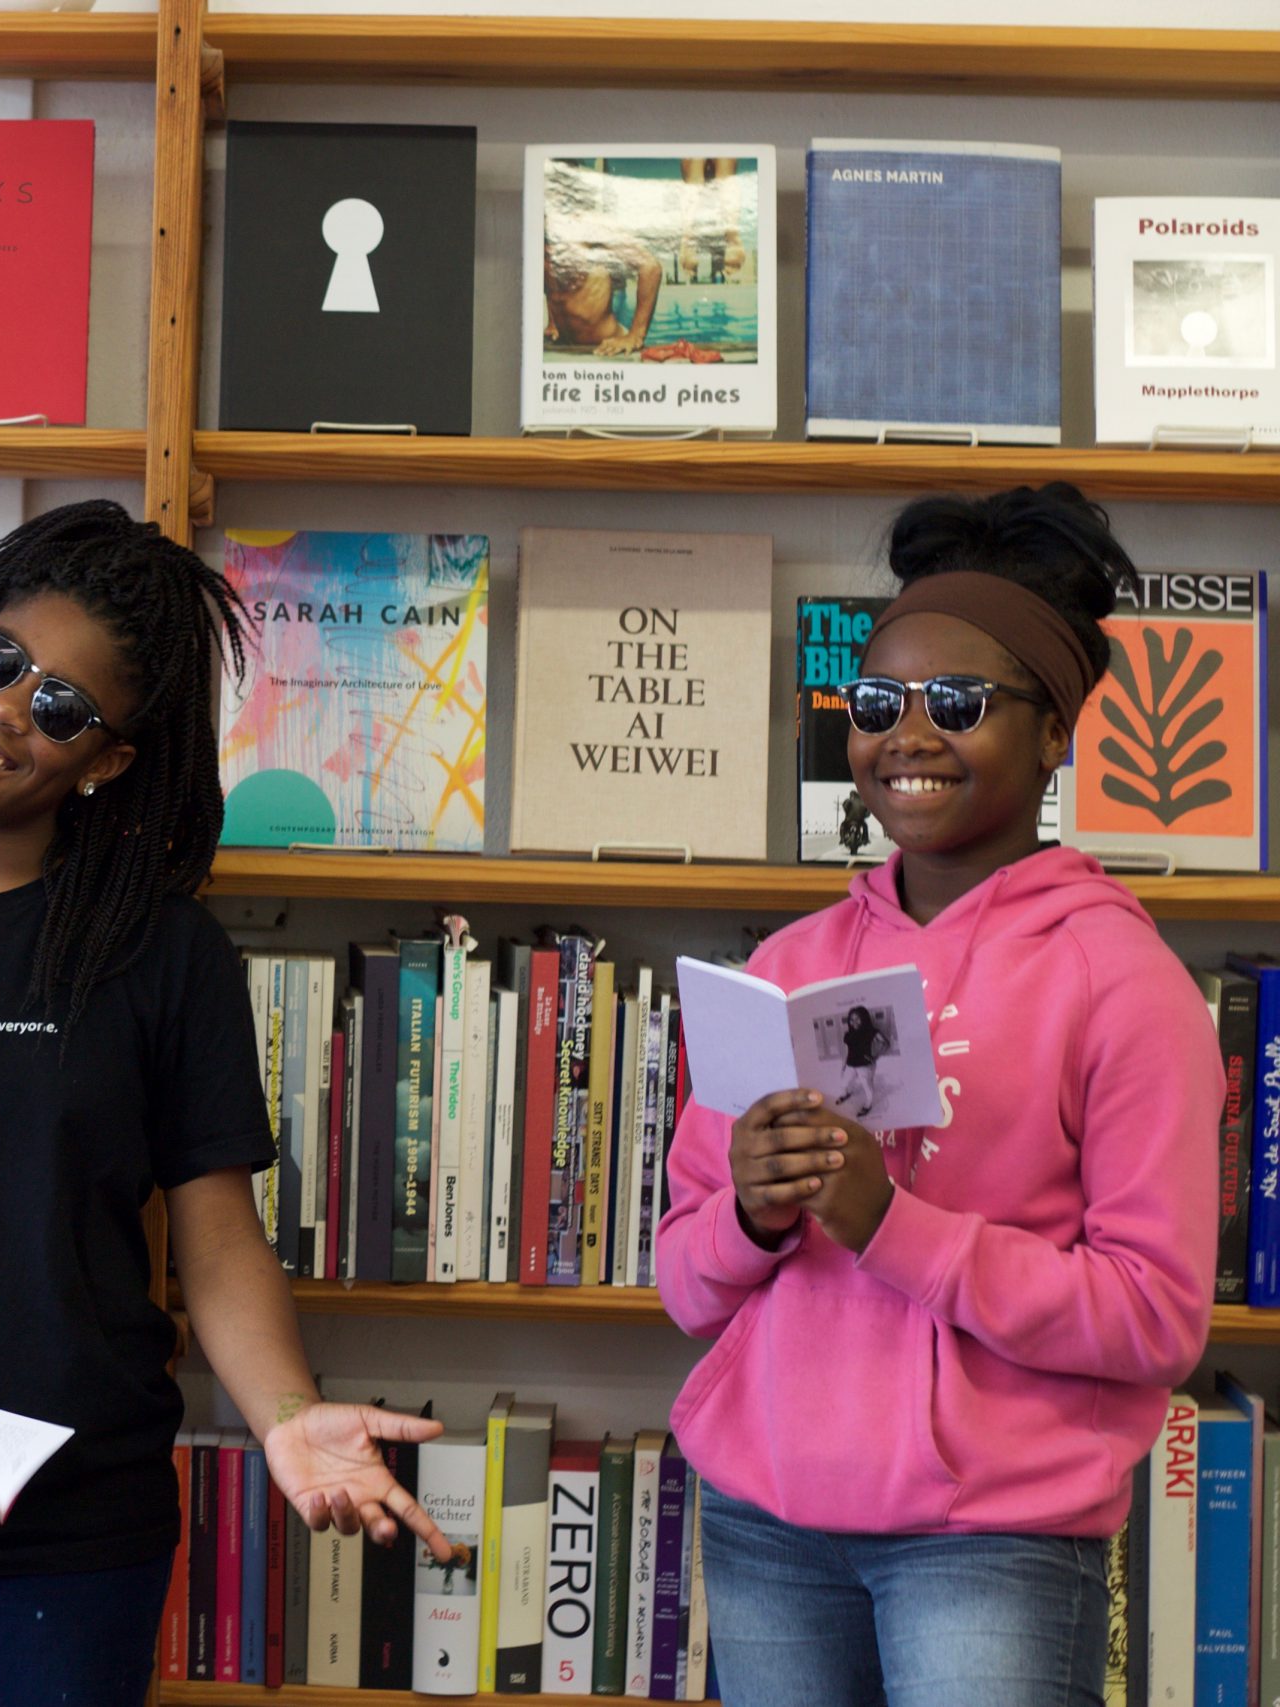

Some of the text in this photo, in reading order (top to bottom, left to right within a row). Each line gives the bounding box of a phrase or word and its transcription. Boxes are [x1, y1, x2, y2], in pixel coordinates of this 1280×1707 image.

[832, 168, 943, 184] AGNES MARTIN
[1138, 218, 1259, 237] Polaroids
[542, 370, 625, 380] tom bianchi
[542, 384, 740, 407] fire island pines
[1142, 385, 1259, 400] Mapplethorpe
[1114, 574, 1252, 613] ATISSE
[253, 601, 460, 626] SARAH CAIN
[619, 607, 679, 636] ON
[803, 603, 872, 645] The
[608, 641, 688, 671] THE
[269, 676, 442, 690] The Imaginary Architecture of Love
[589, 674, 706, 706] TABLE
[626, 712, 664, 739] AI
[570, 743, 720, 777] WEIWEI
[448, 981, 462, 1021] Group
[572, 953, 592, 1060] david hockney
[410, 998, 423, 1052] ITALIAN
[560, 1039, 574, 1084] Secret
[407, 1059, 421, 1131] FUTURISM
[665, 1041, 677, 1130] ABELOW BEERY
[555, 1087, 570, 1168] Knowledge
[1222, 1055, 1243, 1217] SEMINA CULTURE
[588, 1102, 604, 1196] SIXTY STRANGE DAYS
[1264, 1143, 1279, 1164] de
[443, 1175, 457, 1238] Ben Jones
[1166, 1405, 1196, 1497] ARAKI
[1201, 1469, 1246, 1480] BETWEEN
[424, 1493, 475, 1508] Gerhard
[1214, 1485, 1232, 1494] THE
[427, 1508, 472, 1521] Richter
[1209, 1501, 1237, 1510] SHELL
[331, 1539, 340, 1565] DRAW
[547, 1484, 595, 1639] ZERO
[330, 1573, 340, 1603] FAMILY
[428, 1608, 462, 1621] Atlas
[1209, 1629, 1232, 1638] PAUL
[329, 1633, 338, 1664] KARMA
[1197, 1644, 1245, 1653] SALVESON
[558, 1660, 574, 1682] 5
